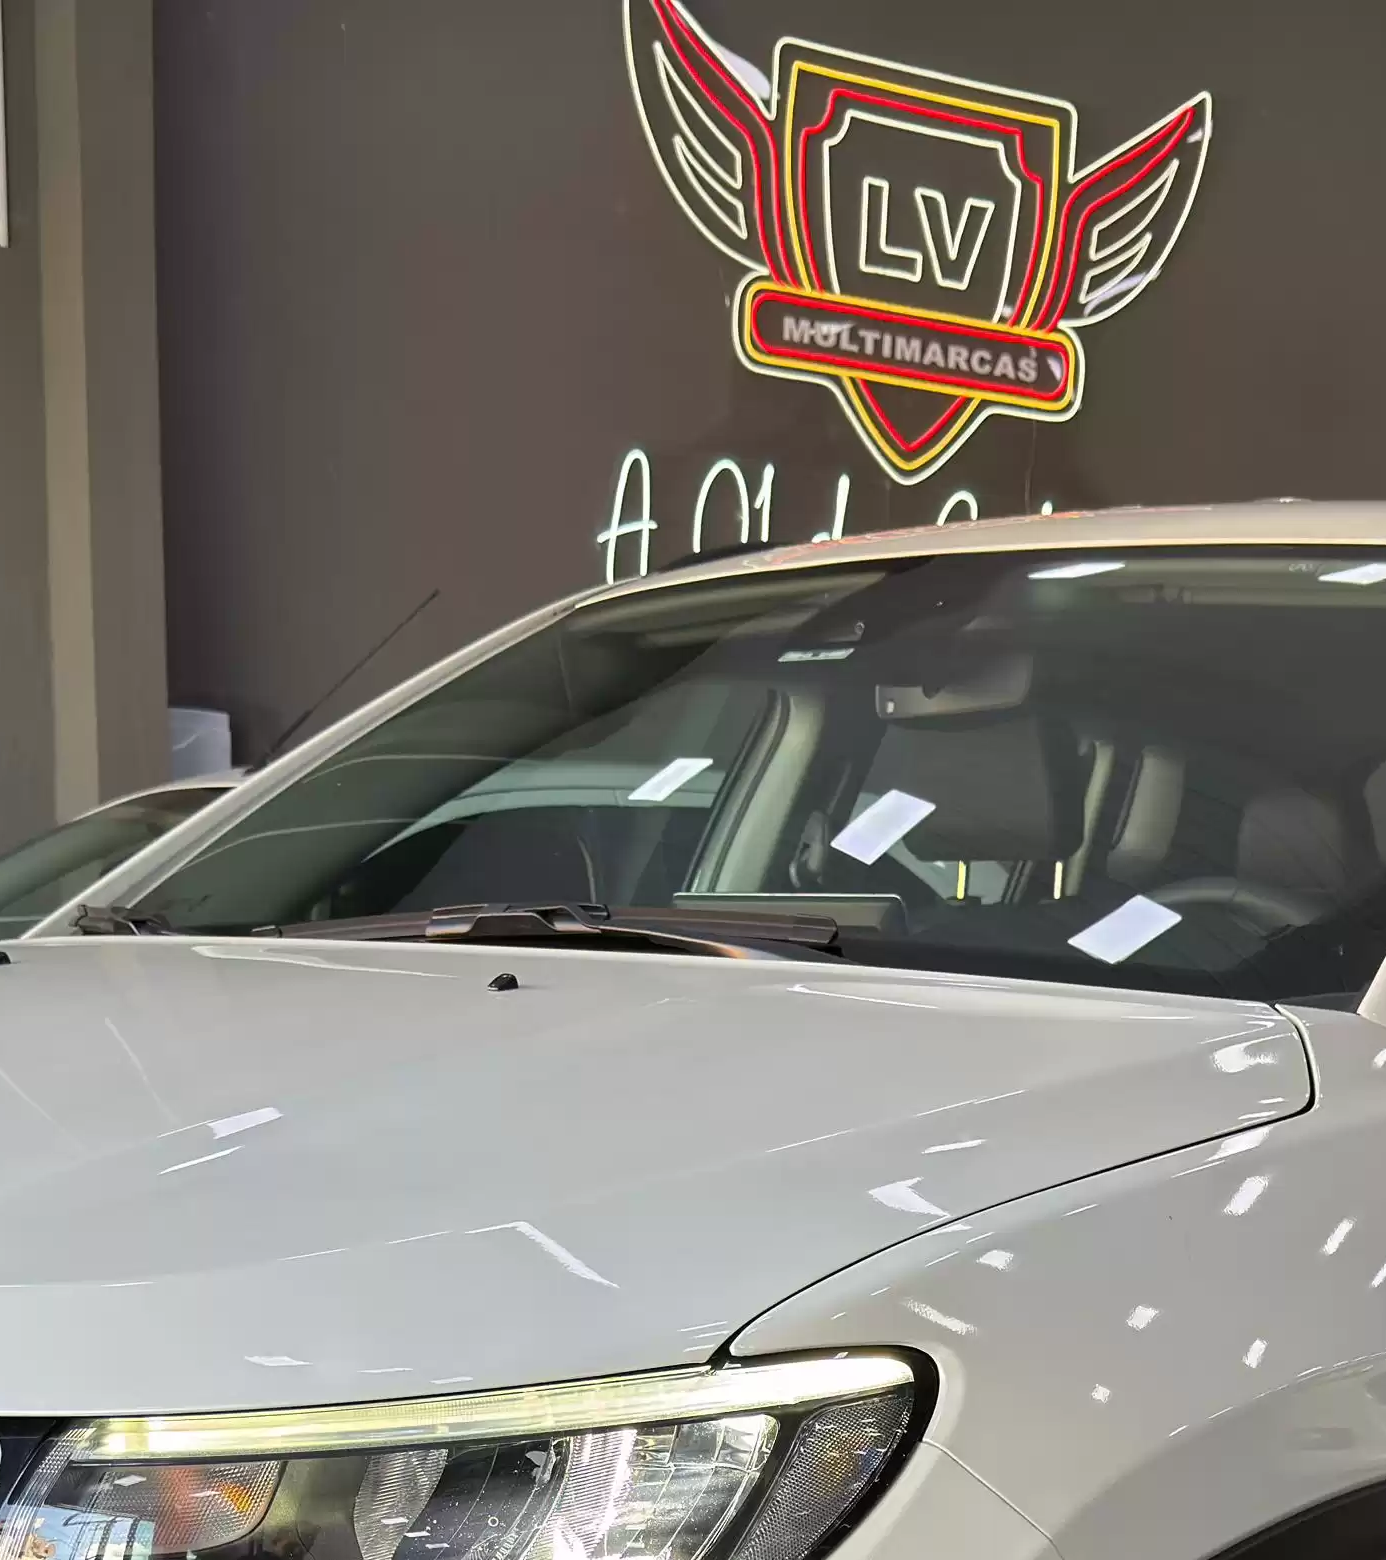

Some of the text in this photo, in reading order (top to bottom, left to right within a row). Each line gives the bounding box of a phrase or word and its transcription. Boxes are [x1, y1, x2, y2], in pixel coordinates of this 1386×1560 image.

[858, 176, 996, 290] LV
[782, 315, 1039, 384] MULTIMARCAS
[597, 448, 658, 584] A
